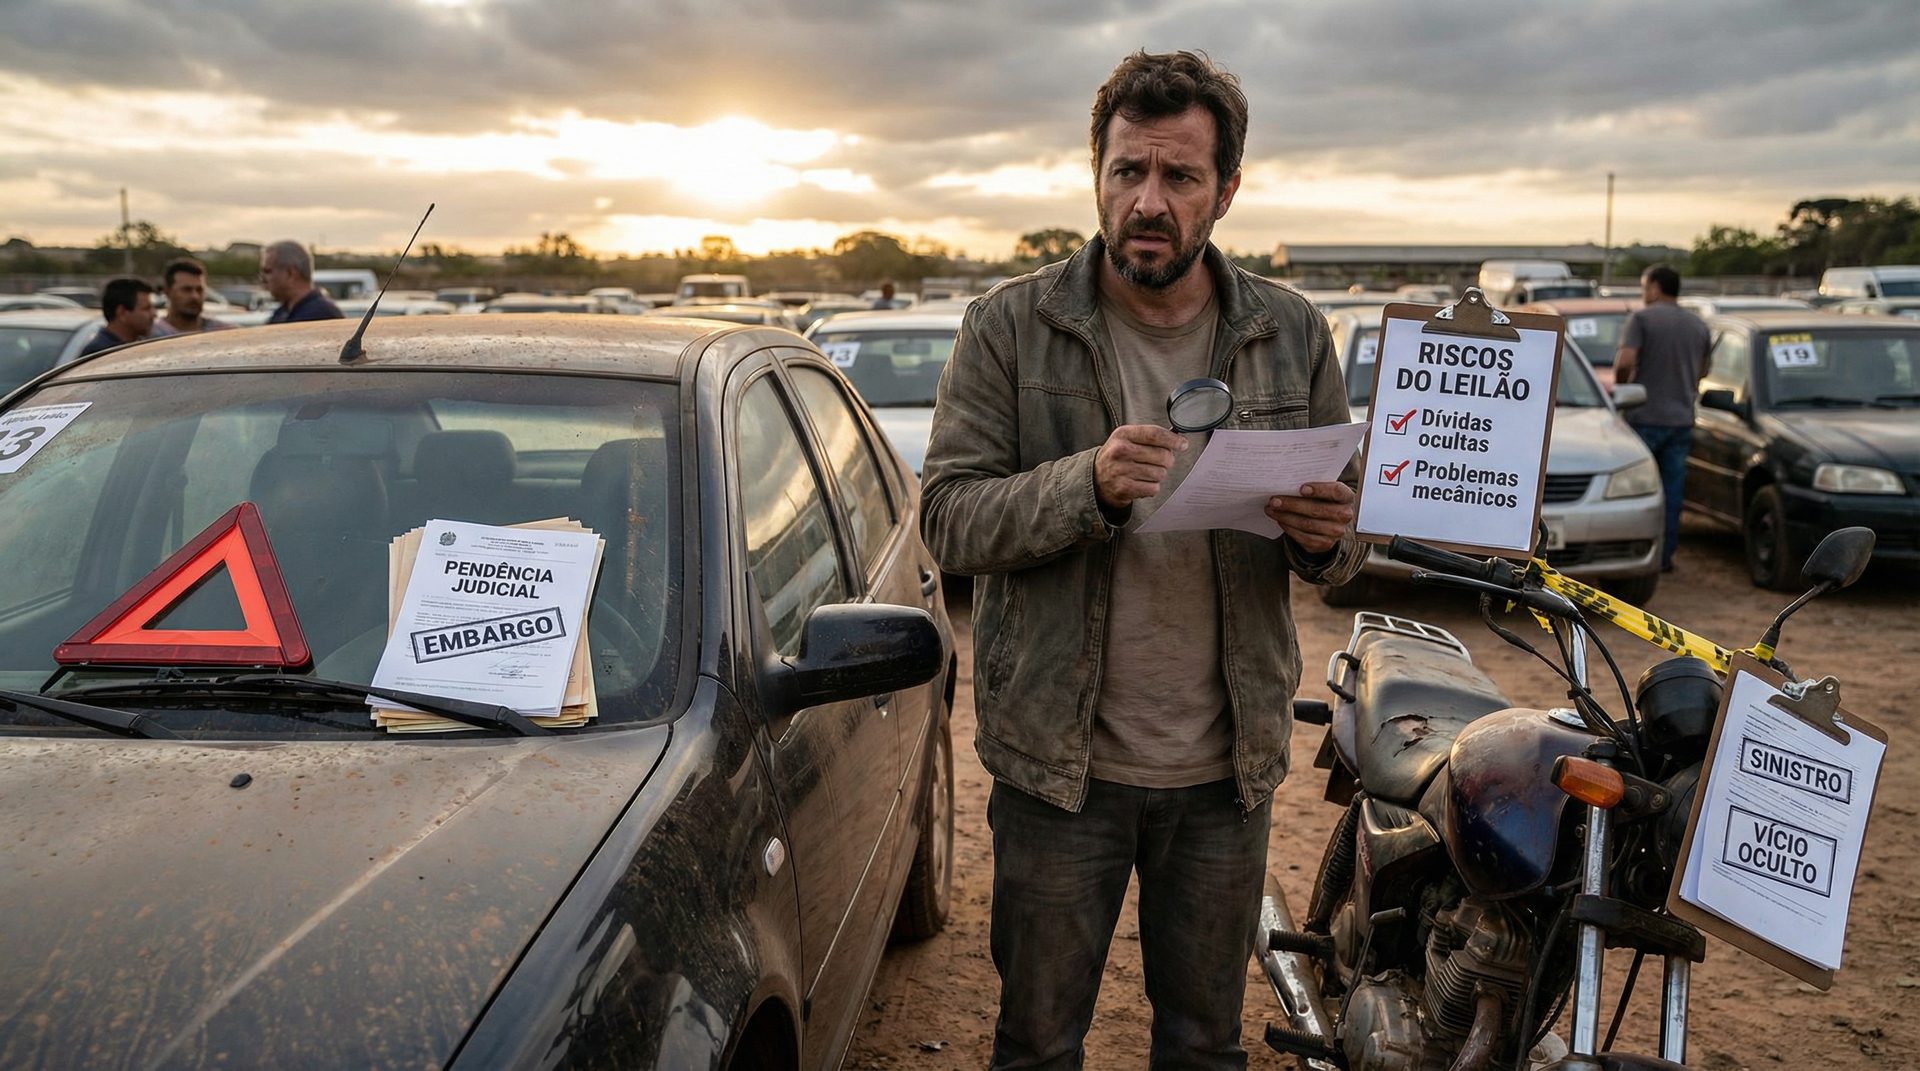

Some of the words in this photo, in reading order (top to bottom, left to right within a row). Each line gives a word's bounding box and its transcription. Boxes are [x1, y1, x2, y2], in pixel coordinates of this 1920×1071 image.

[1418, 342, 1514, 371] RISCOS
[1779, 348, 1809, 363] 19
[1396, 367, 1432, 392] DO
[1439, 371, 1530, 401] LEILÃO
[1421, 408, 1493, 432] Dívidas
[0, 426, 46, 460] 3
[1418, 431, 1490, 453] ocultas
[1414, 459, 1519, 487] Problemas
[1412, 484, 1518, 509] mecânicos
[444, 560, 554, 583] PENDÊNCIA
[451, 578, 540, 599] JUDICIAL
[423, 616, 554, 655] EMBARGO
[1750, 748, 1842, 793] SINISTRO
[1754, 821, 1808, 857] VÍCIO
[1738, 842, 1817, 884] OCULTO
